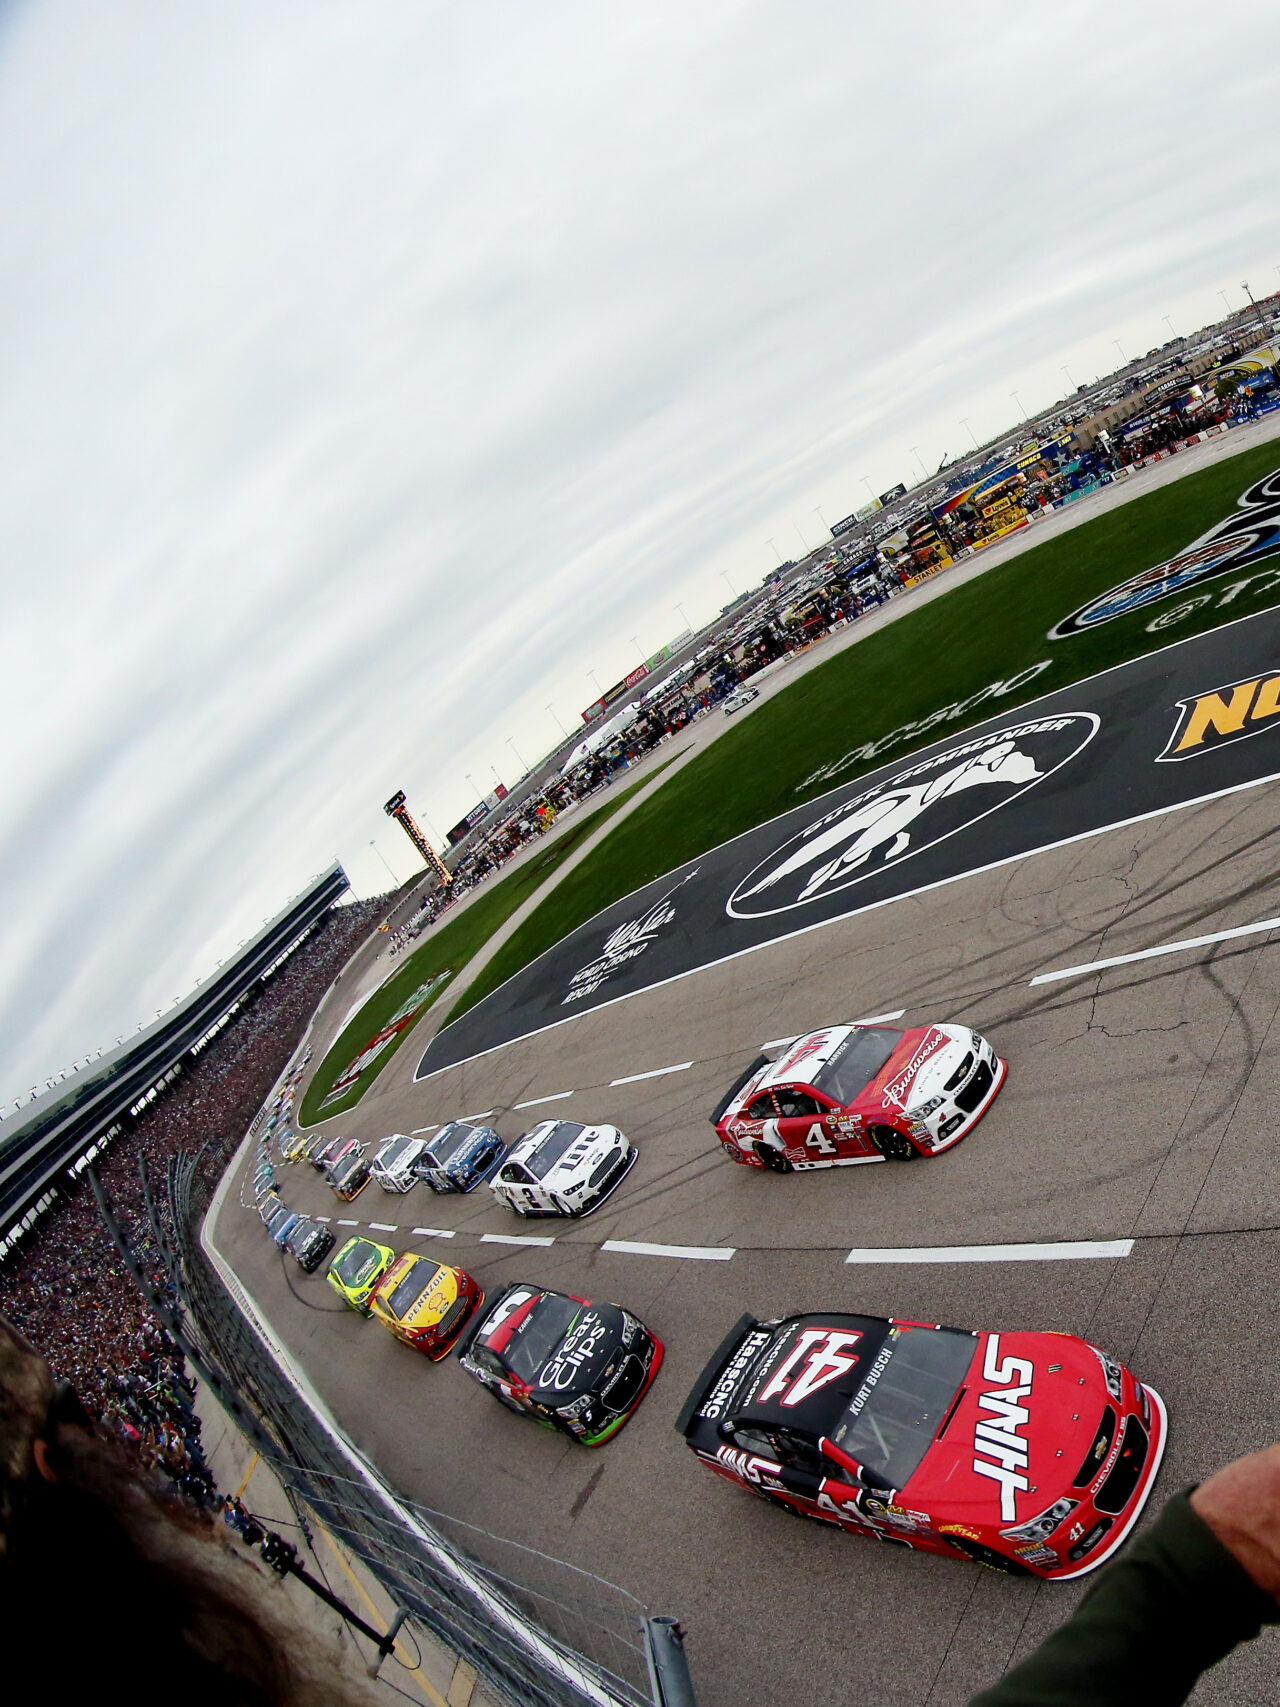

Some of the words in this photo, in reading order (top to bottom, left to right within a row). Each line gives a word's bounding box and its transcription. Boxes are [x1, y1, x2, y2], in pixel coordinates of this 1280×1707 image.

[1014, 451, 1042, 471] SUNOCO
[990, 497, 1010, 513] Love's
[913, 561, 943, 584] STANLEY
[623, 666, 648, 687] Coca-Cola
[803, 782, 888, 837] BUCK
[892, 718, 1075, 784] COMMANDER
[827, 1042, 850, 1067] HARVICK
[882, 1029, 944, 1109] Budweise
[937, 1111, 947, 1123] 4
[558, 1129, 600, 1171] Lite
[805, 1123, 836, 1155] 4
[522, 1188, 542, 1207] 2
[575, 1190, 584, 1199] 2
[407, 1270, 449, 1322] PENNZOIL
[517, 1313, 535, 1334] KAHNE
[538, 1310, 600, 1388] Great
[554, 1321, 610, 1391] Clips
[728, 1330, 756, 1365] America's
[599, 1363, 625, 1396] CHEVROLET
[704, 1331, 773, 1420] HaasCNC
[742, 1322, 800, 1408] HaasCNC.com
[757, 1326, 864, 1407] 41
[708, 1366, 731, 1398] Machine
[850, 1384, 871, 1417] KURT
[869, 1347, 894, 1387] BUSCH
[585, 1410, 593, 1422] 5
[699, 1399, 713, 1416] Tool
[973, 1333, 1035, 1522] HAAS
[1089, 1432, 1122, 1494] CHEVROLET
[816, 1493, 878, 1529] 41
[1068, 1522, 1086, 1542] 41
